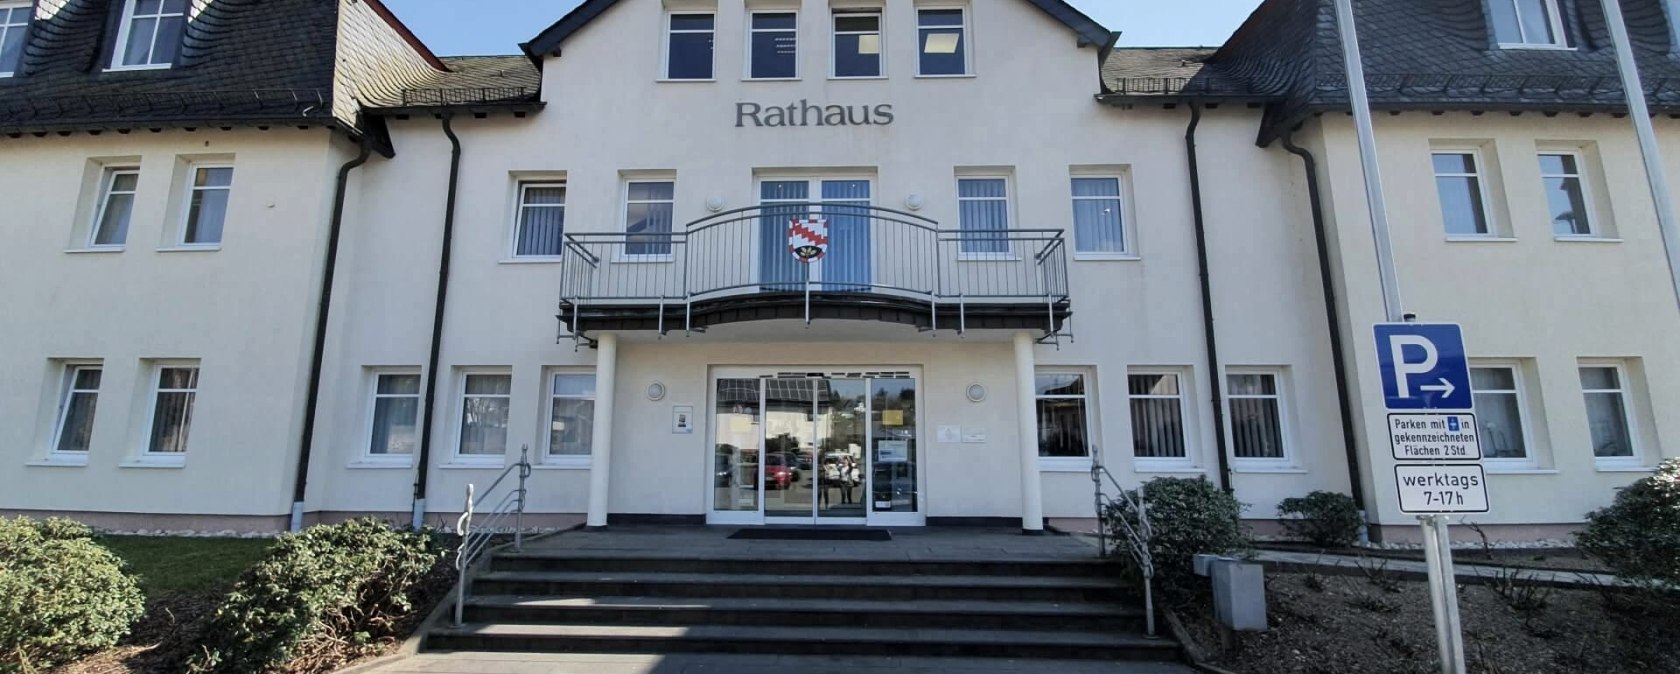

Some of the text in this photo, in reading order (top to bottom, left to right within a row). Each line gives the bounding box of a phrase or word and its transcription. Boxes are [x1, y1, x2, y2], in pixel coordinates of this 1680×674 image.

[735, 99, 894, 127] Rathaus
[1389, 335, 1438, 398] P
[1394, 418, 1469, 429] Parken mit in
[1394, 432, 1475, 445] gekennzeichneten
[1404, 445, 1440, 456] Flächen
[1402, 472, 1478, 489] werktags
